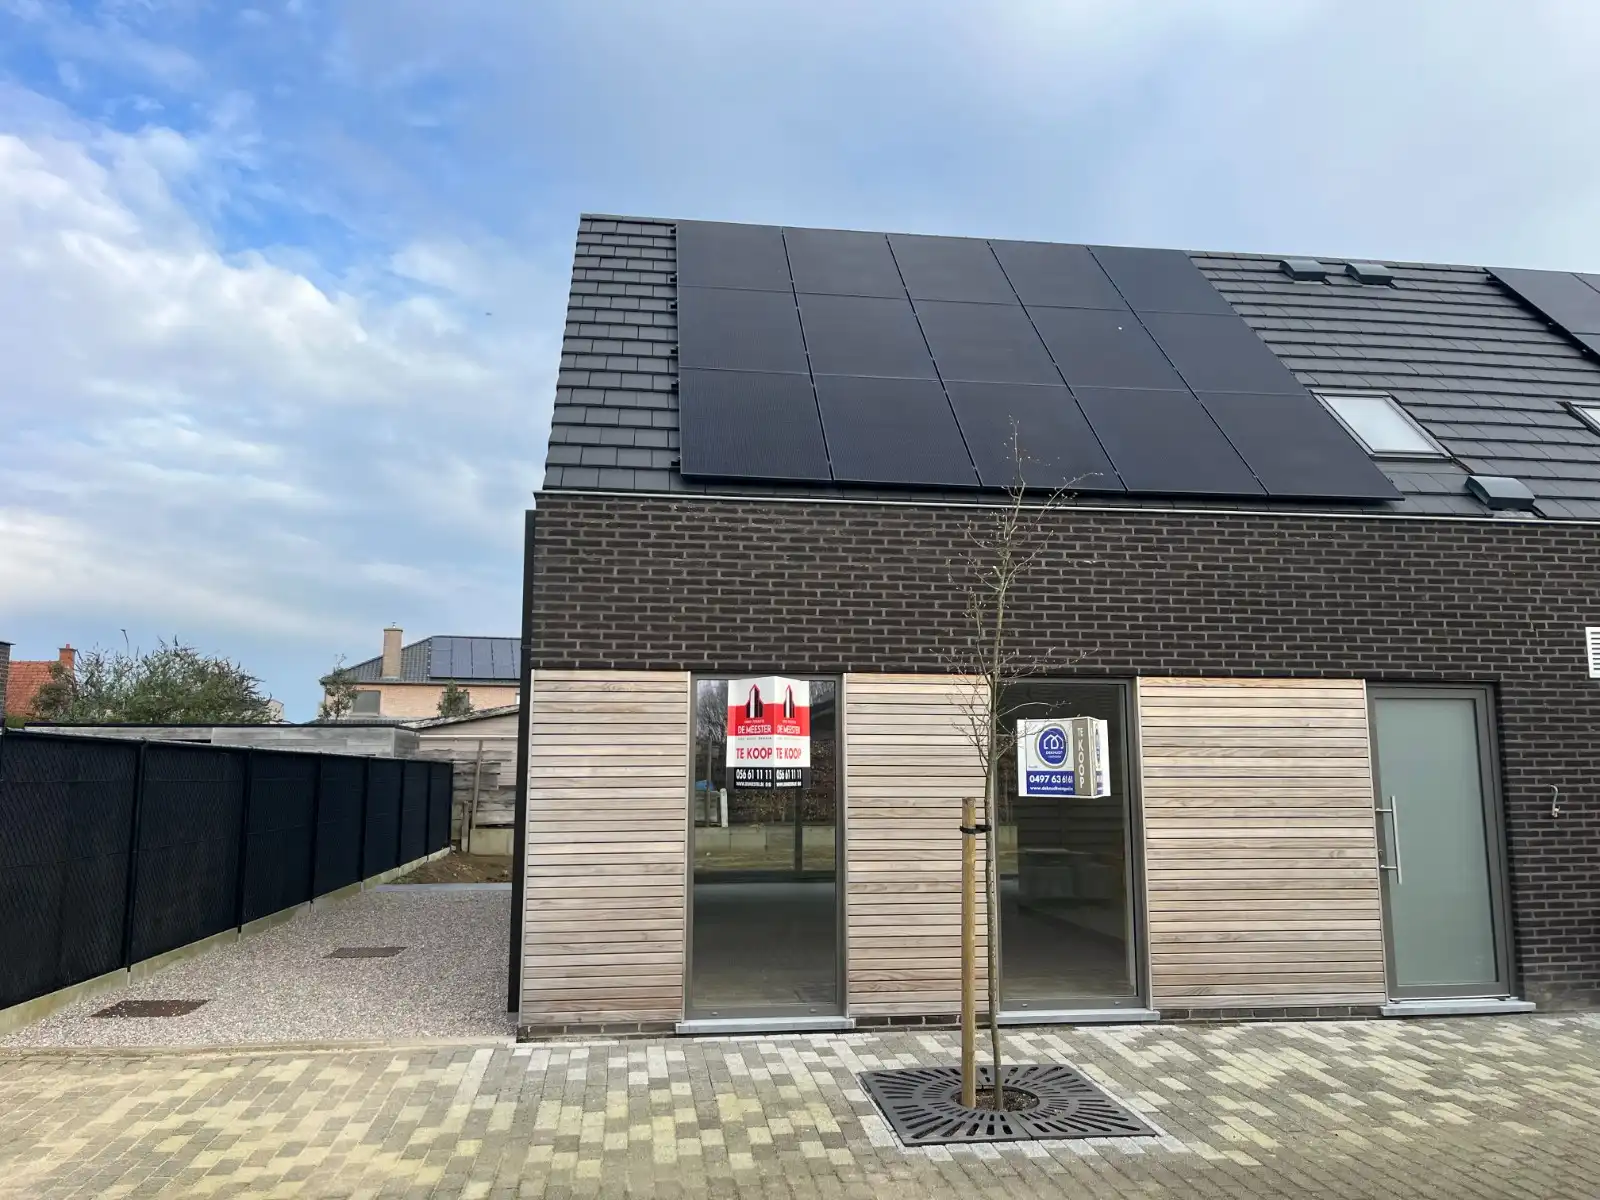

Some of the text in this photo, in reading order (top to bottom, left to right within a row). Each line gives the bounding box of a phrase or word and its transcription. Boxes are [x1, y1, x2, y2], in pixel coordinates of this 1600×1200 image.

[738, 725, 772, 734] DE MEESTER
[777, 725, 783, 734] DE
[1078, 728, 1084, 737] TE
[736, 748, 773, 759] TE KOOP
[776, 748, 802, 759] TE KOOP
[736, 769, 772, 779] 056 61 11 11
[1029, 775, 1050, 783] 0497
[1051, 775, 1061, 783] 63
